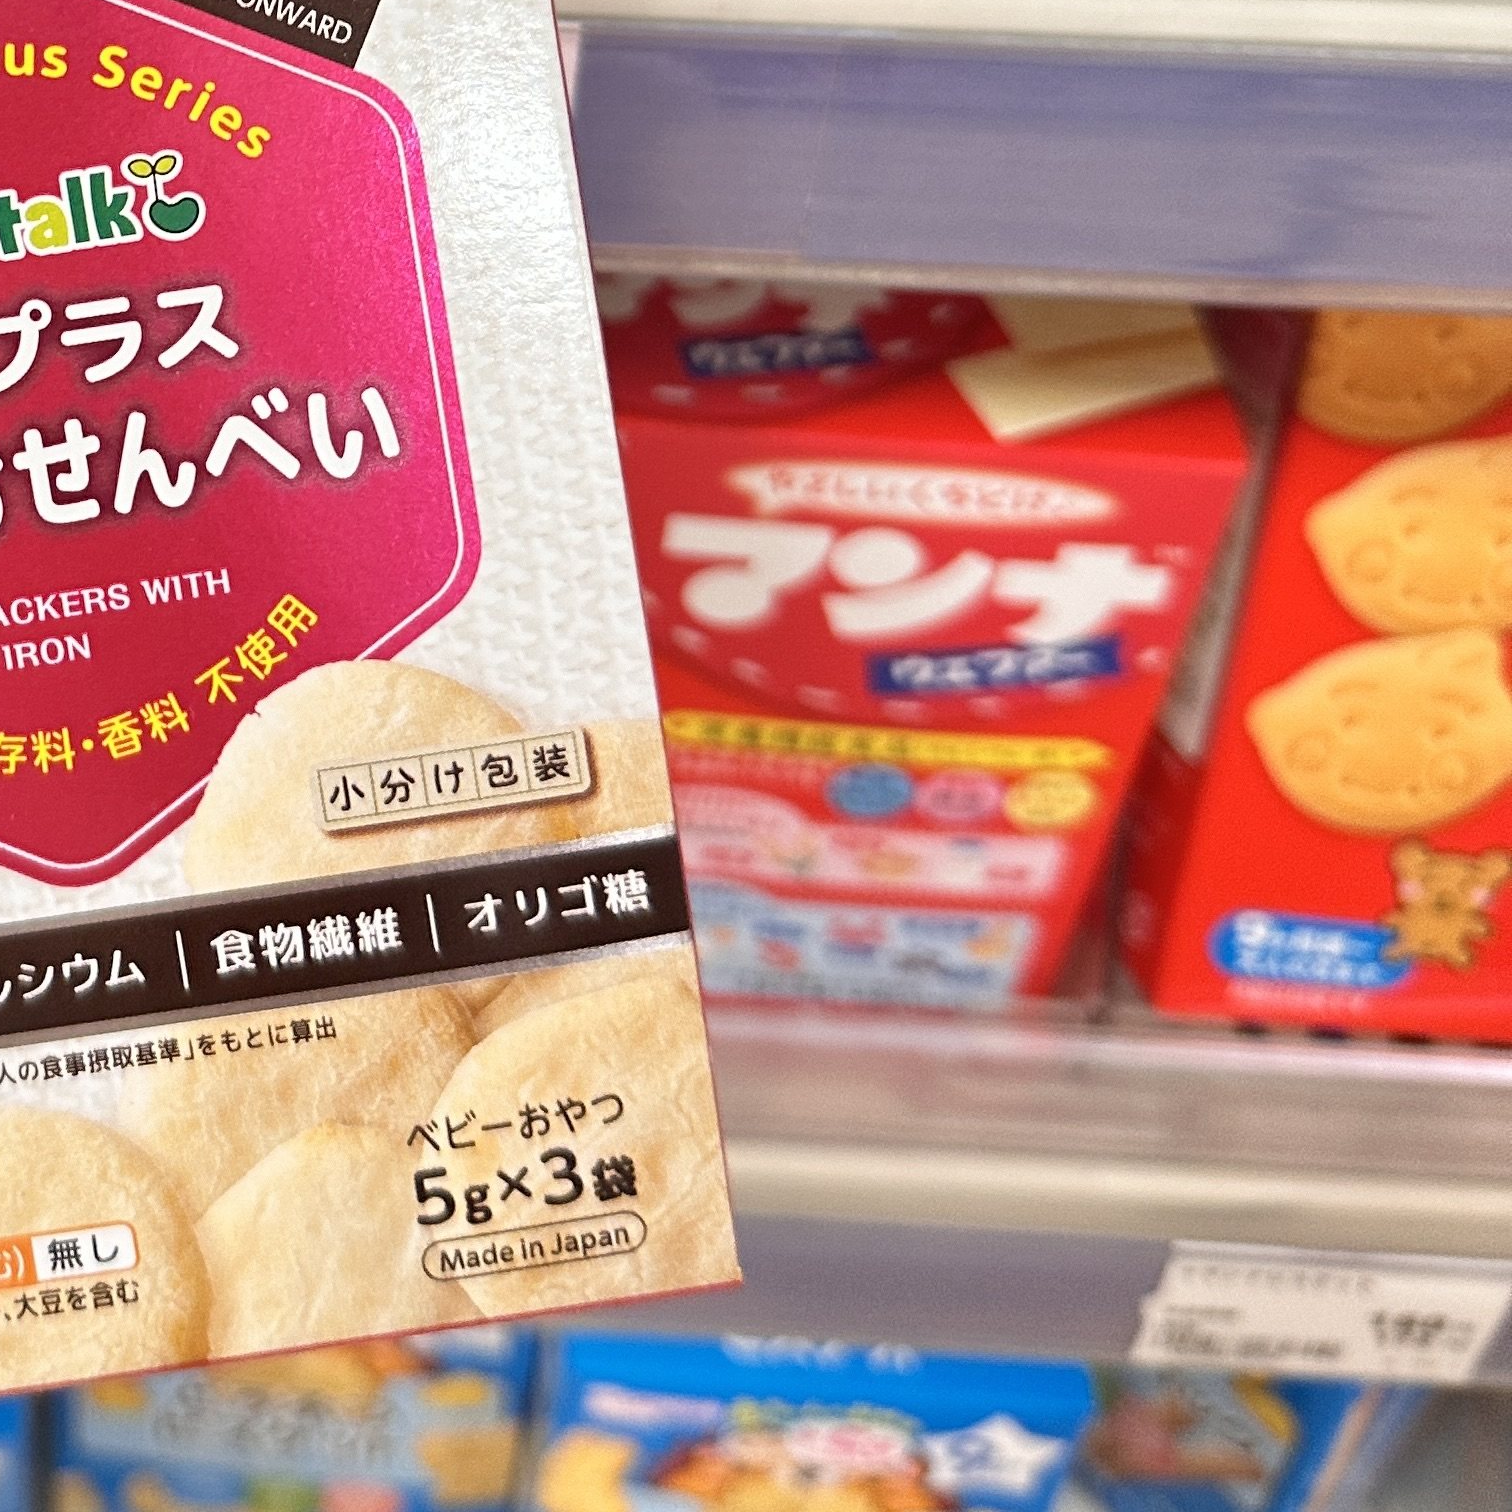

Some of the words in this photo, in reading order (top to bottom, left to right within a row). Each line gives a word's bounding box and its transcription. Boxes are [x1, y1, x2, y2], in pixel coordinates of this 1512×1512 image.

[91, 44, 273, 161] Series
[140, 566, 233, 607] WITH
[660, 510, 1171, 646] マンナ
[0, 631, 93, 673] IRON
[194, 593, 320, 706] 不使用
[329, 743, 573, 813] 小分け包装
[209, 906, 404, 977] 食物繊維
[462, 867, 650, 934] オリゴ糖
[406, 1091, 625, 1152] ベビーおやつ
[46, 1232, 121, 1273] 無し
[438, 1239, 515, 1274] Made
[520, 1238, 545, 1260] in
[550, 1224, 631, 1259] Japan
